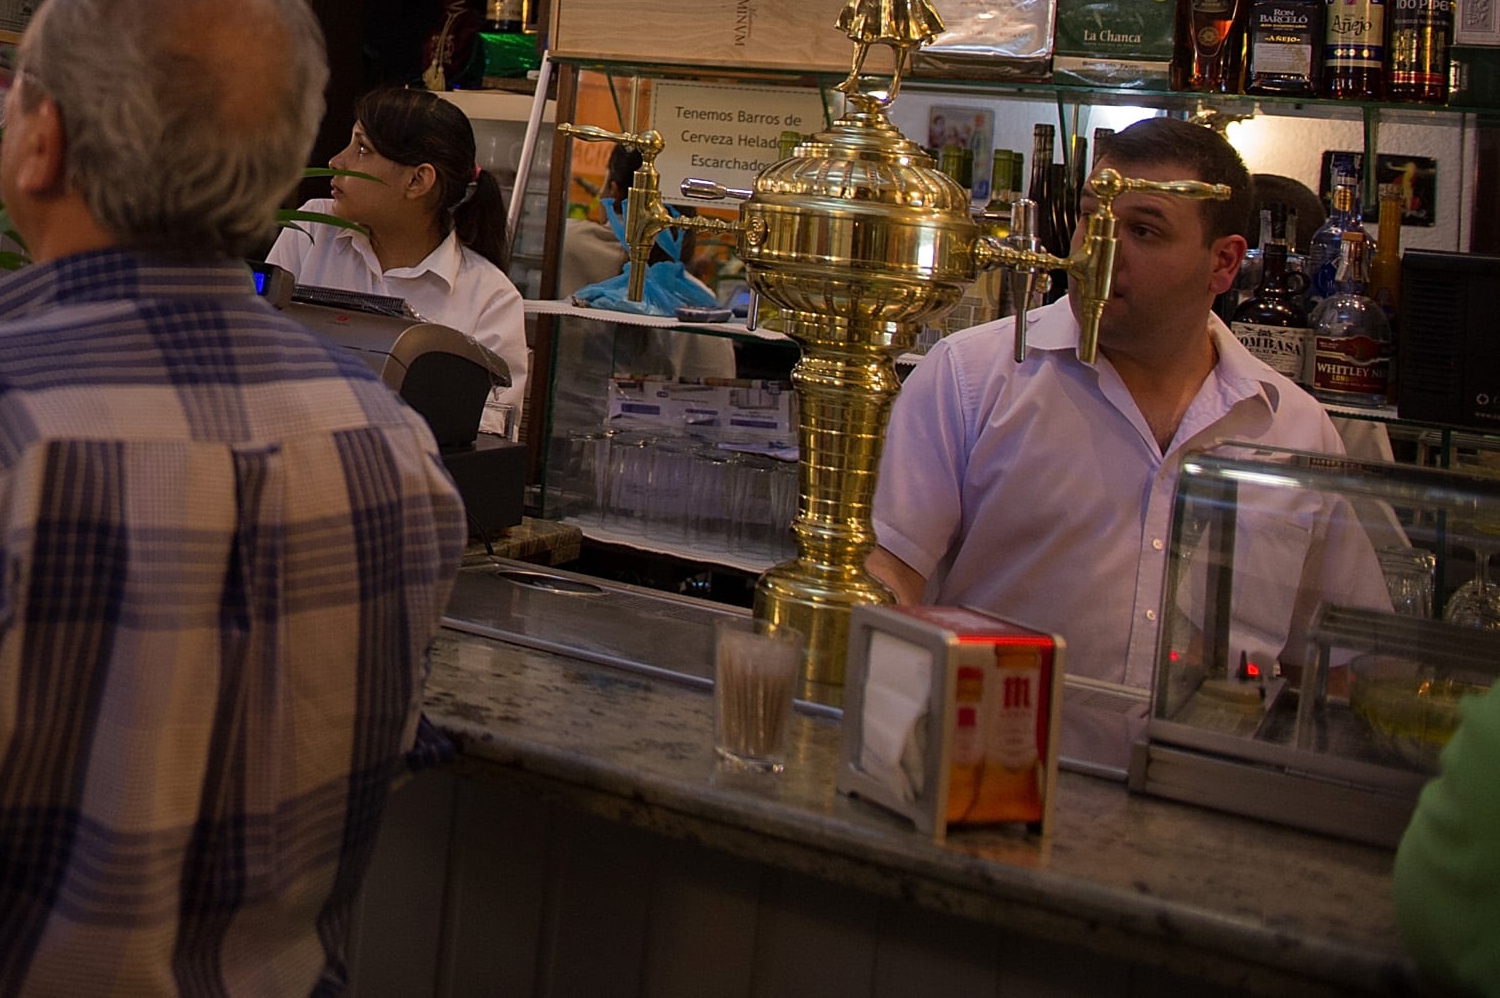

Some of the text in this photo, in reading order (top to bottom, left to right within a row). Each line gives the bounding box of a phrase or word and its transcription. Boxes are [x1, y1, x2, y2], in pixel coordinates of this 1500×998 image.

[1260, 14, 1308, 24] BARCELÓ
[1274, 8, 1295, 16] RON
[1332, 14, 1372, 36] Añejo
[1084, 30, 1142, 44] La Chanca
[676, 106, 802, 128] Tenemos Barros de
[681, 130, 734, 146] Cerveza
[1316, 362, 1370, 377] WHITLEY
